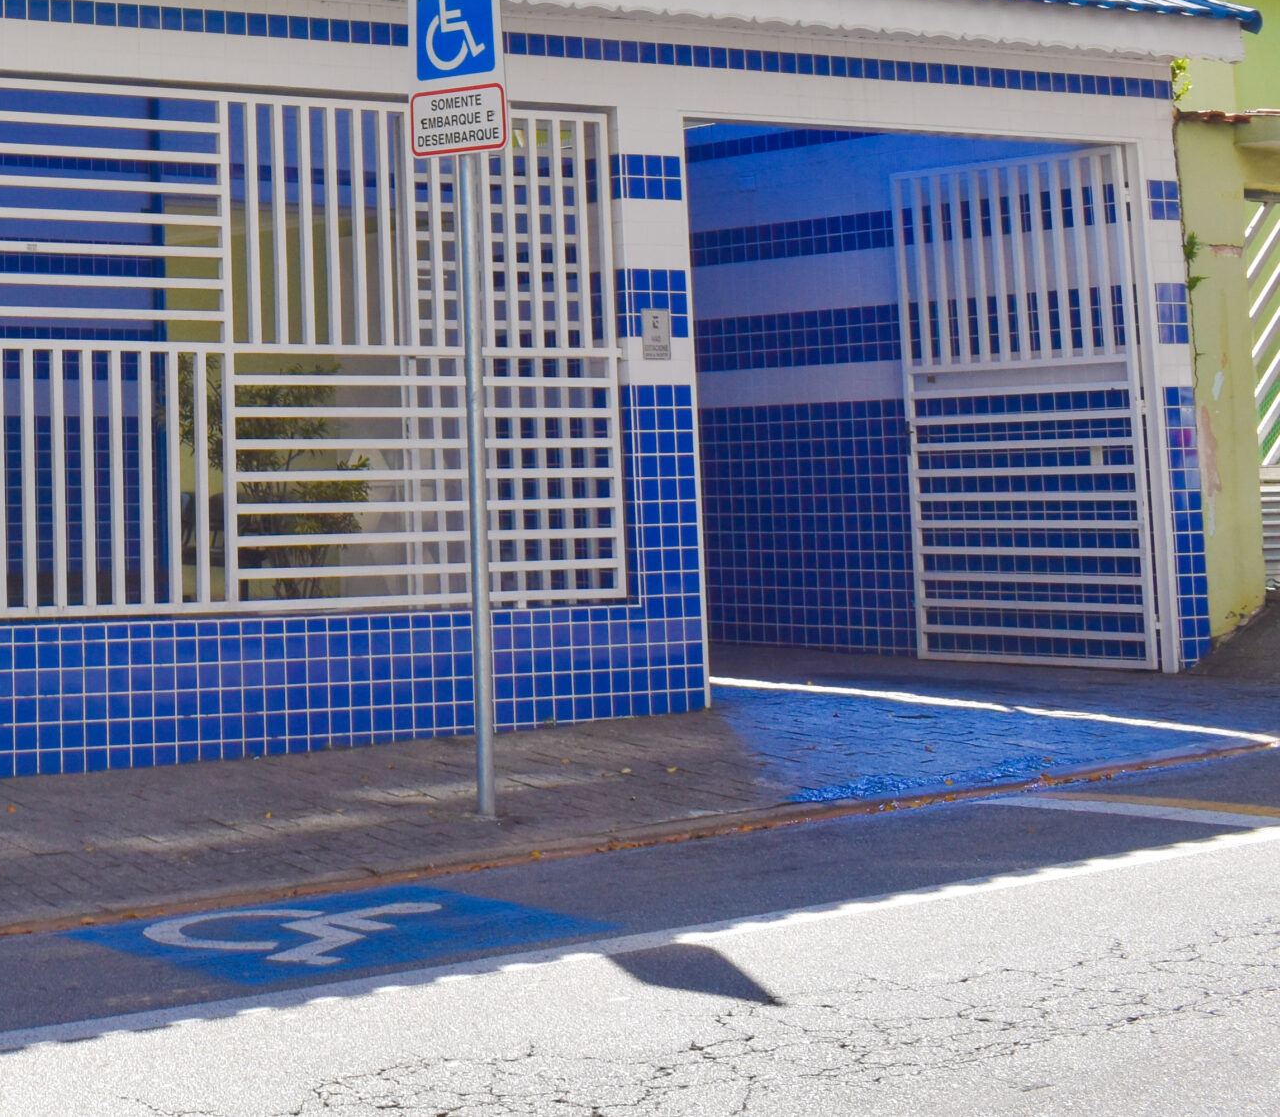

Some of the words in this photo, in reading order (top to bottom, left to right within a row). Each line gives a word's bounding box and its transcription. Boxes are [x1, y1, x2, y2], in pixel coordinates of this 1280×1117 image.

[431, 93, 482, 112] SOMENTE
[421, 111, 481, 130] EMBARQUE
[487, 110, 494, 122] E
[418, 127, 500, 148] DESEMBARQUE
